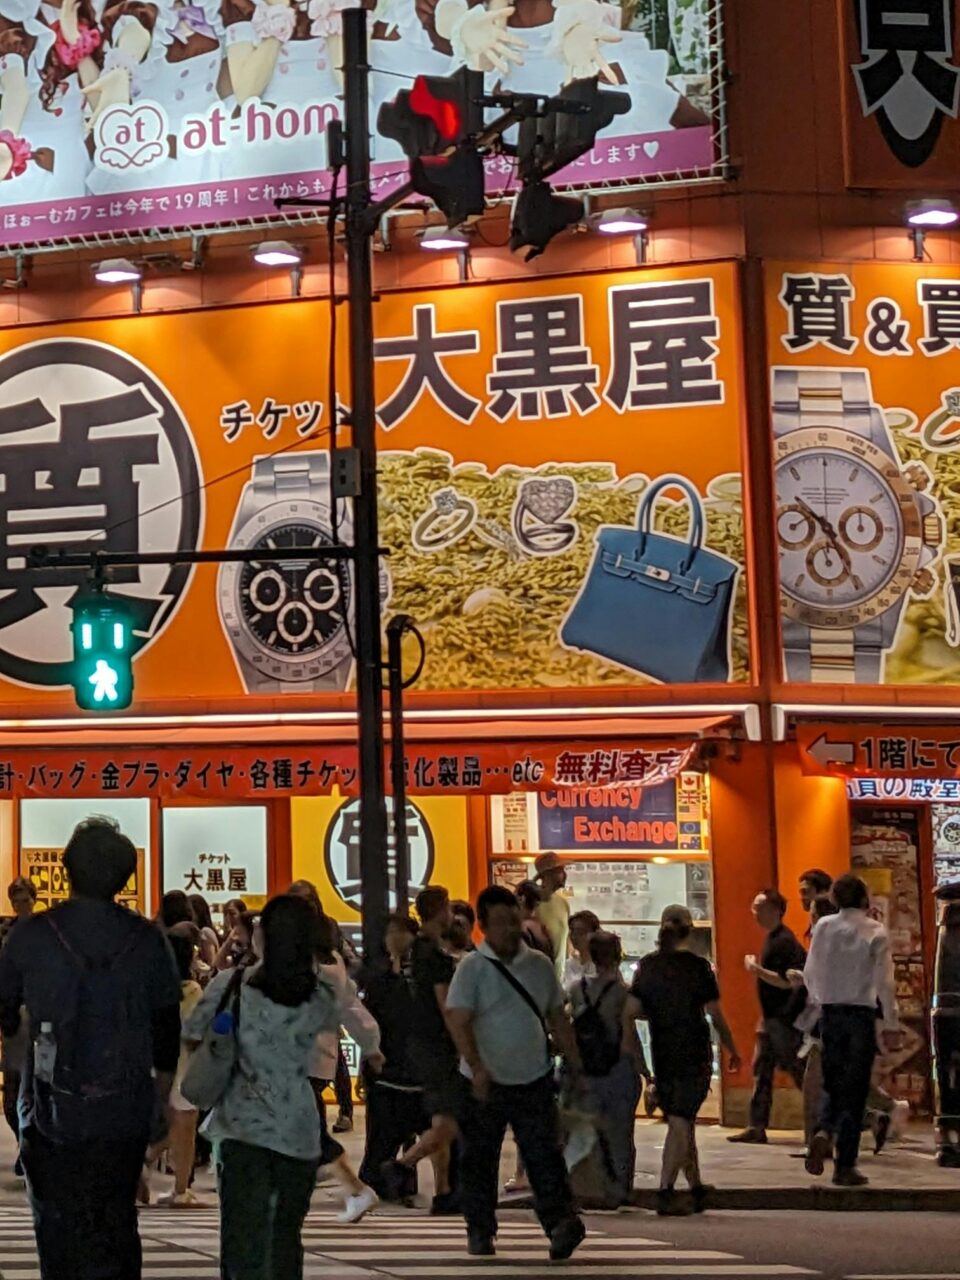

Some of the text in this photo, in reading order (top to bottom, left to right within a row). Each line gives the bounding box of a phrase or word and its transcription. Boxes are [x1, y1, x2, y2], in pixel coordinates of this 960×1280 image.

[183, 102, 339, 150] at-hom
[375, 280, 724, 428] 大黒屋
[541, 786, 642, 810] Currency
[573, 815, 677, 844] Exchange
[198, 852, 231, 864] チケット
[184, 867, 248, 892] 大黒屋
